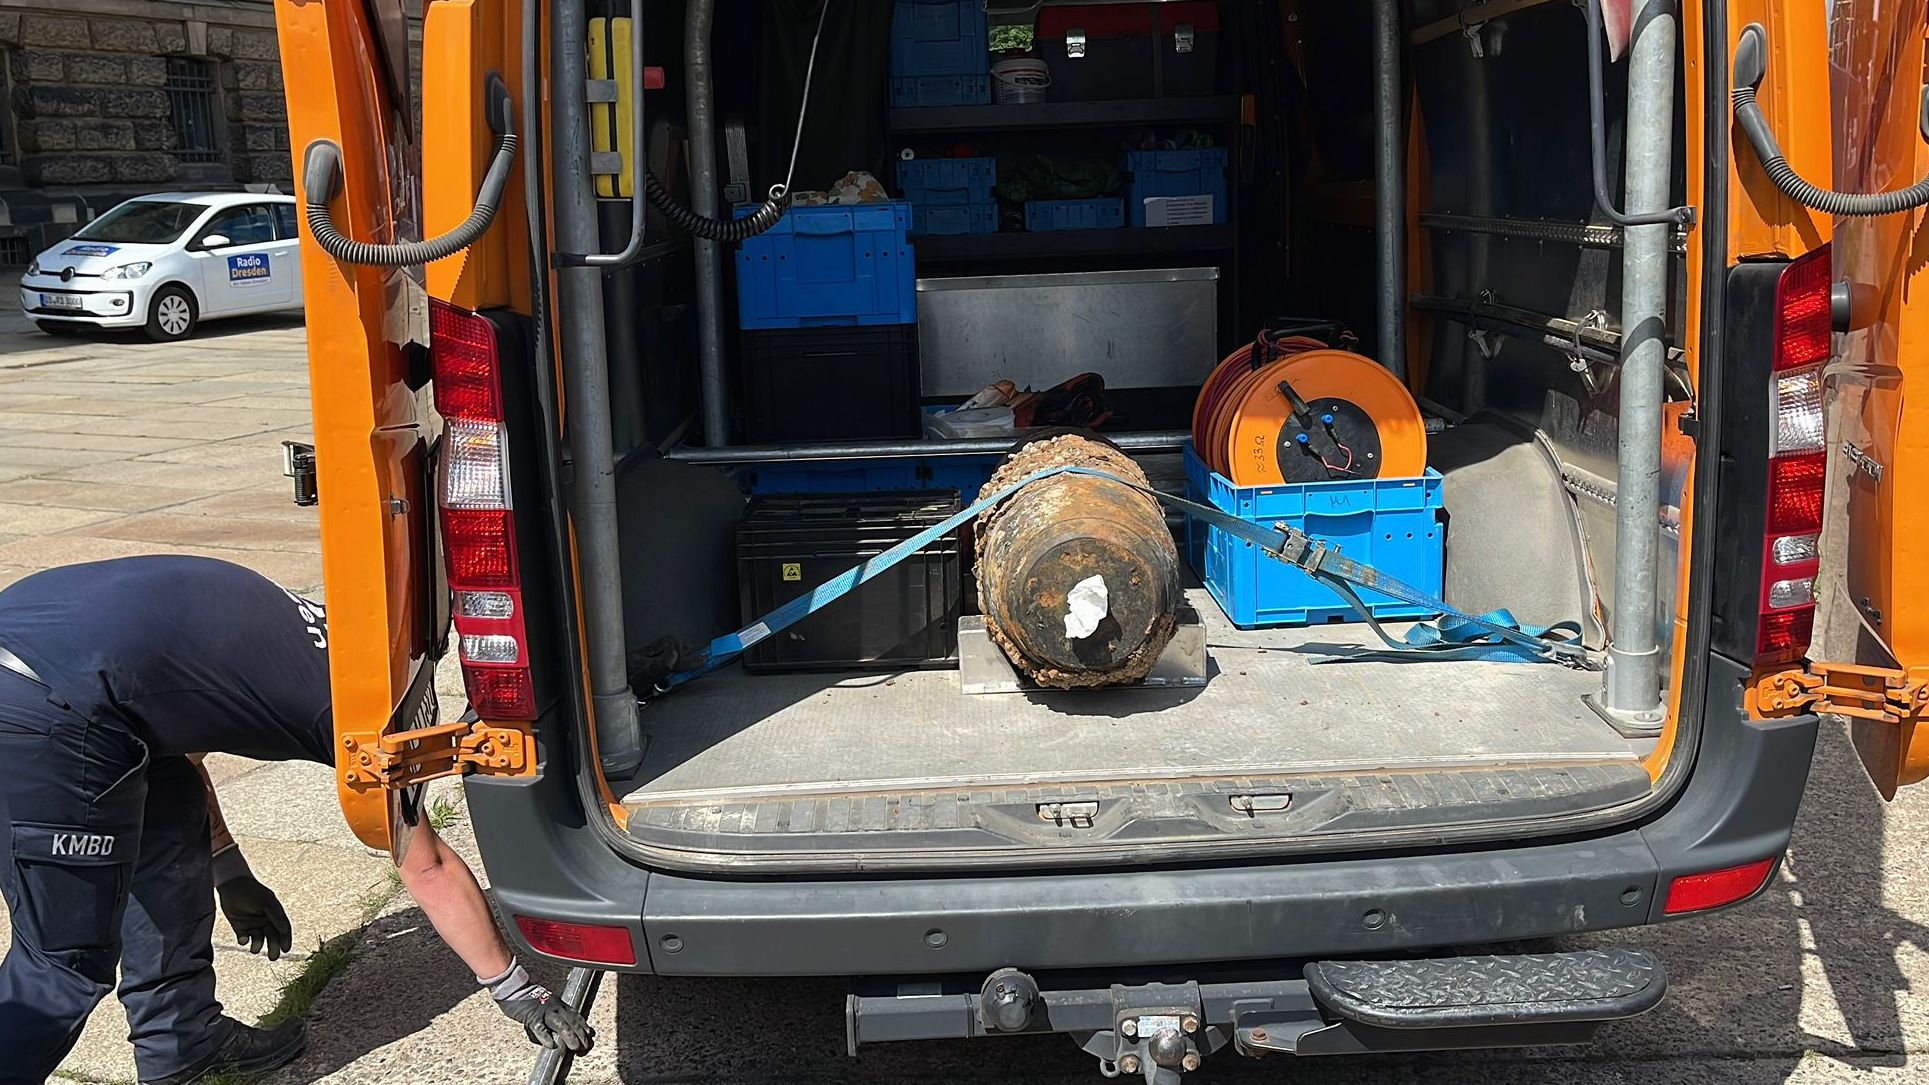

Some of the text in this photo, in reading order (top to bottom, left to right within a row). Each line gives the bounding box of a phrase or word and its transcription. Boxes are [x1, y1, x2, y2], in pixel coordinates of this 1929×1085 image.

[236, 256, 261, 268] Radio
[231, 267, 267, 278] Dresden
[51, 833, 115, 856] KMBD
